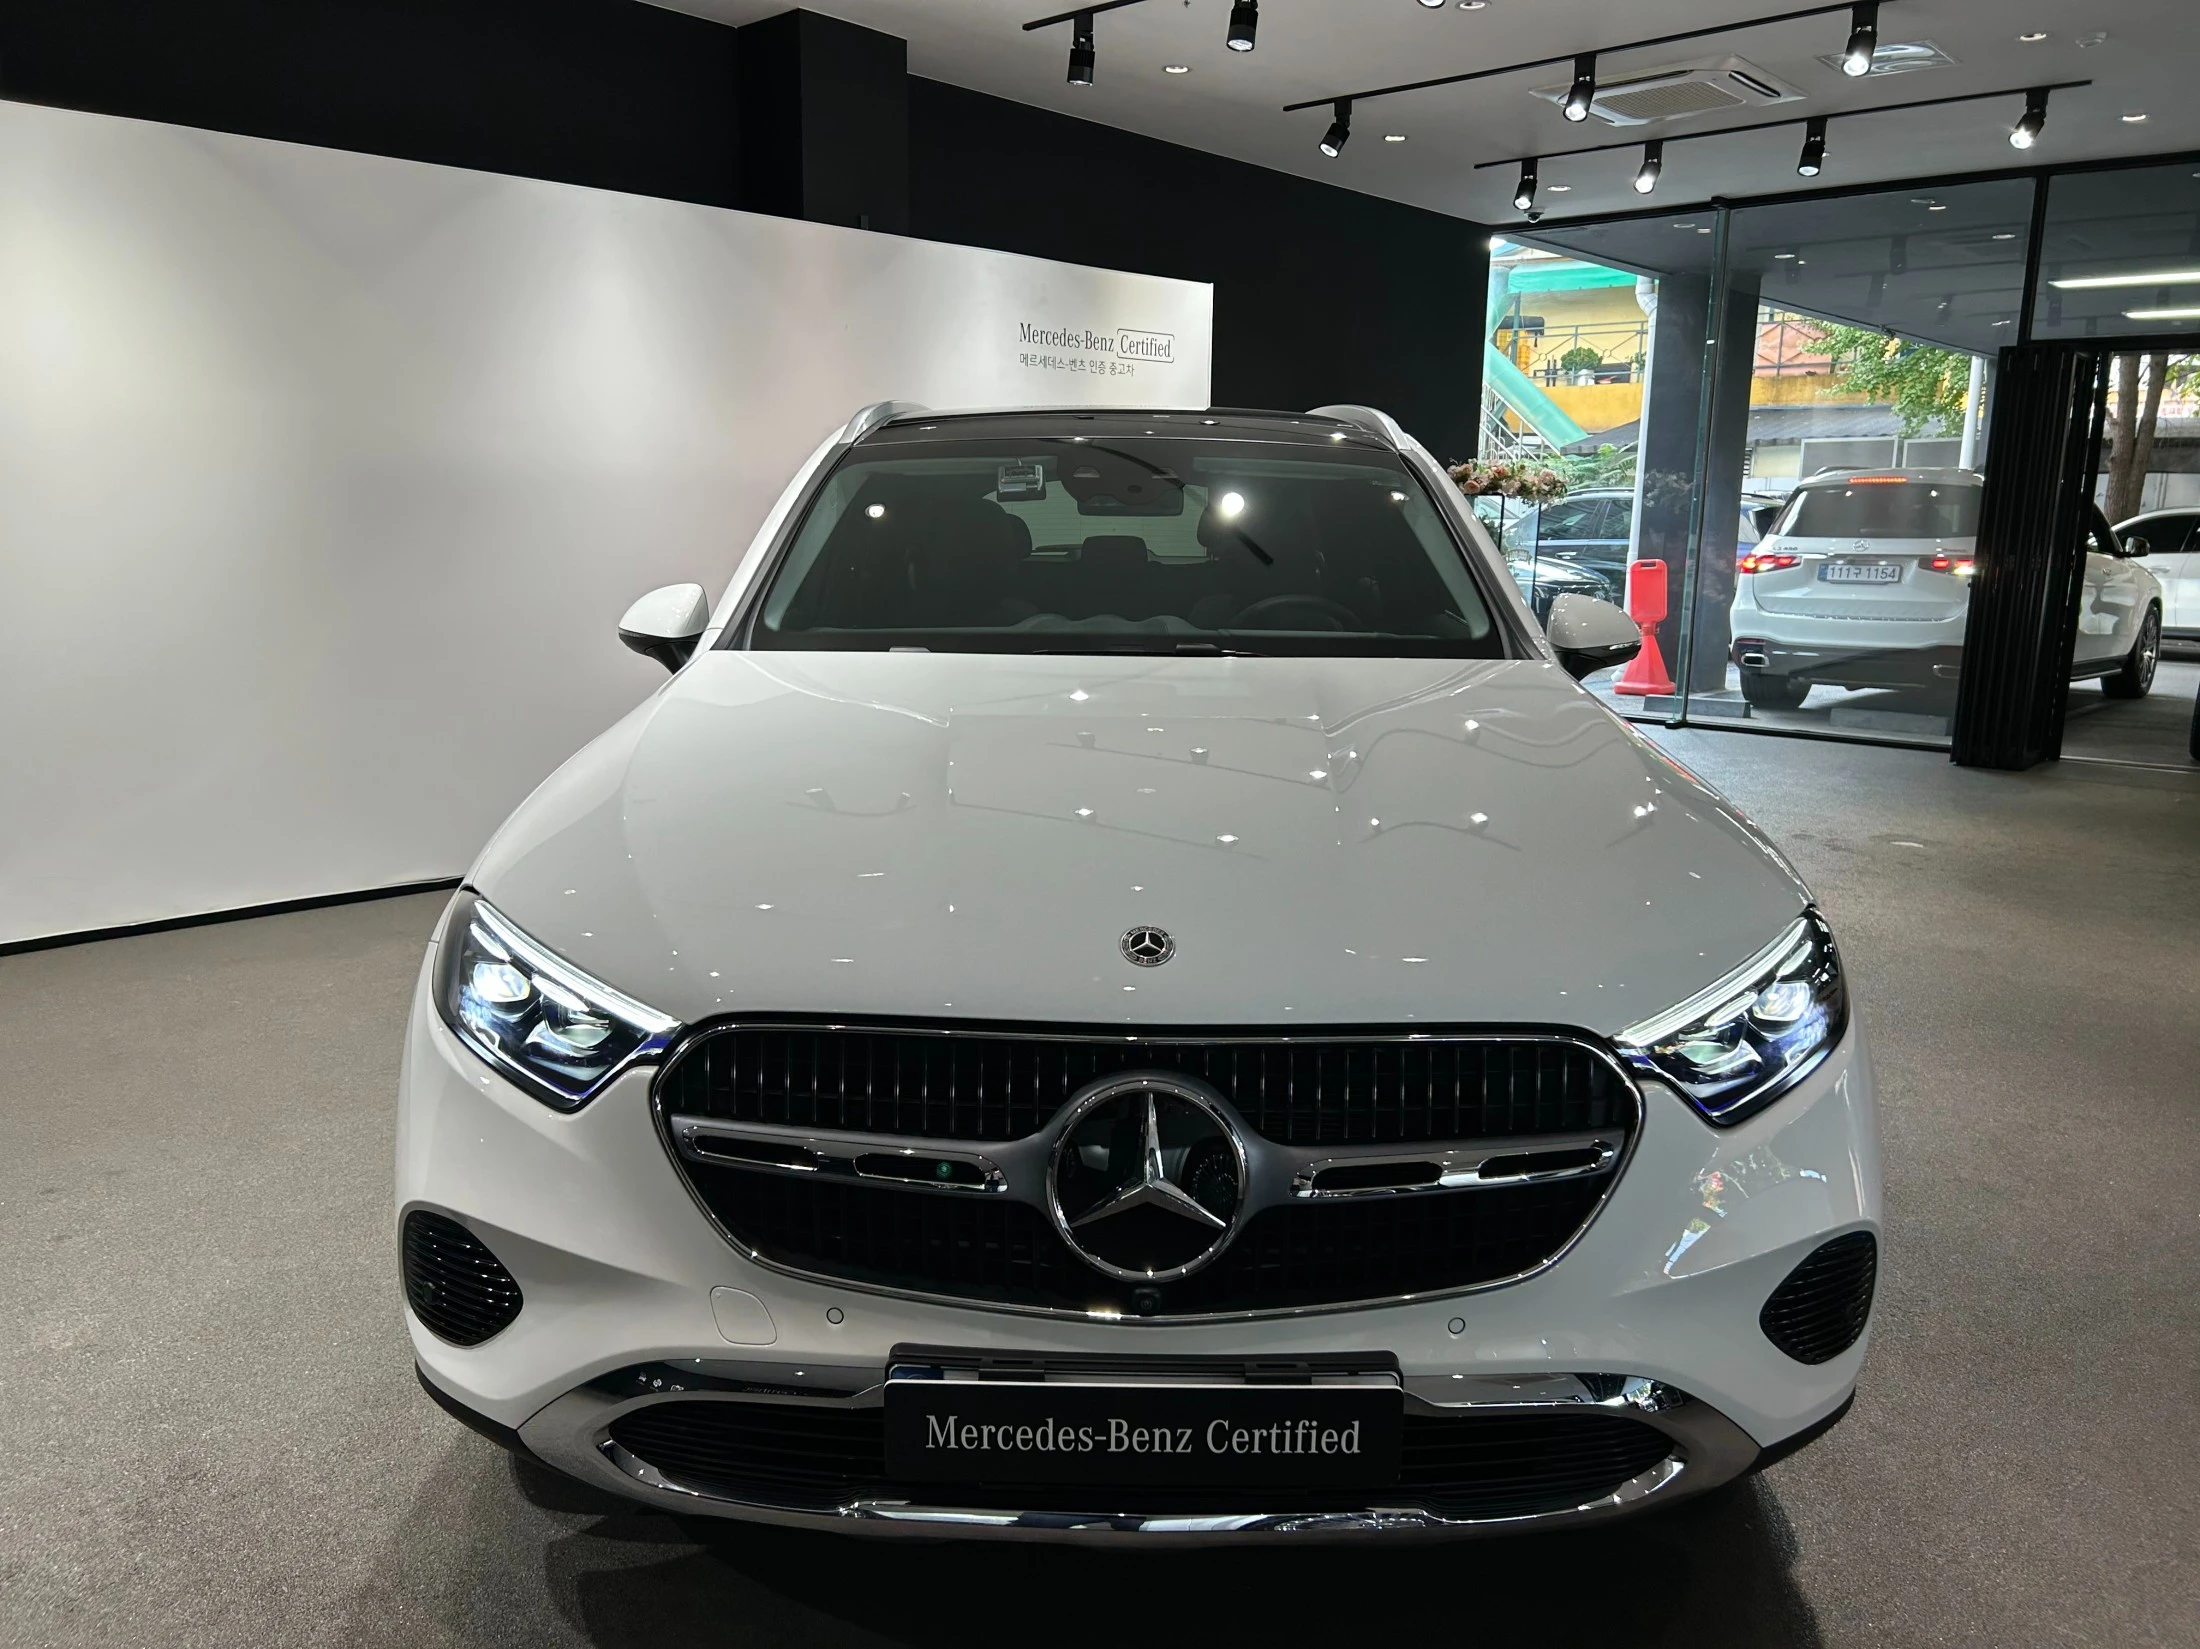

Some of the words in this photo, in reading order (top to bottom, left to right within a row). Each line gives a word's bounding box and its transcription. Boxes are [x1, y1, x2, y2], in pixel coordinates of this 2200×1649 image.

[1019, 322, 1114, 352] Mercedes-Benz
[1120, 334, 1171, 358] Certified
[1019, 353, 1087, 372] 메르세데스-벤츠
[1089, 359, 1107, 375] 인증
[1109, 361, 1135, 377] 중고차
[1866, 567, 1896, 580] 1154
[925, 1414, 1193, 1453] Mercedes-Benz
[1206, 1418, 1361, 1455] Certified
